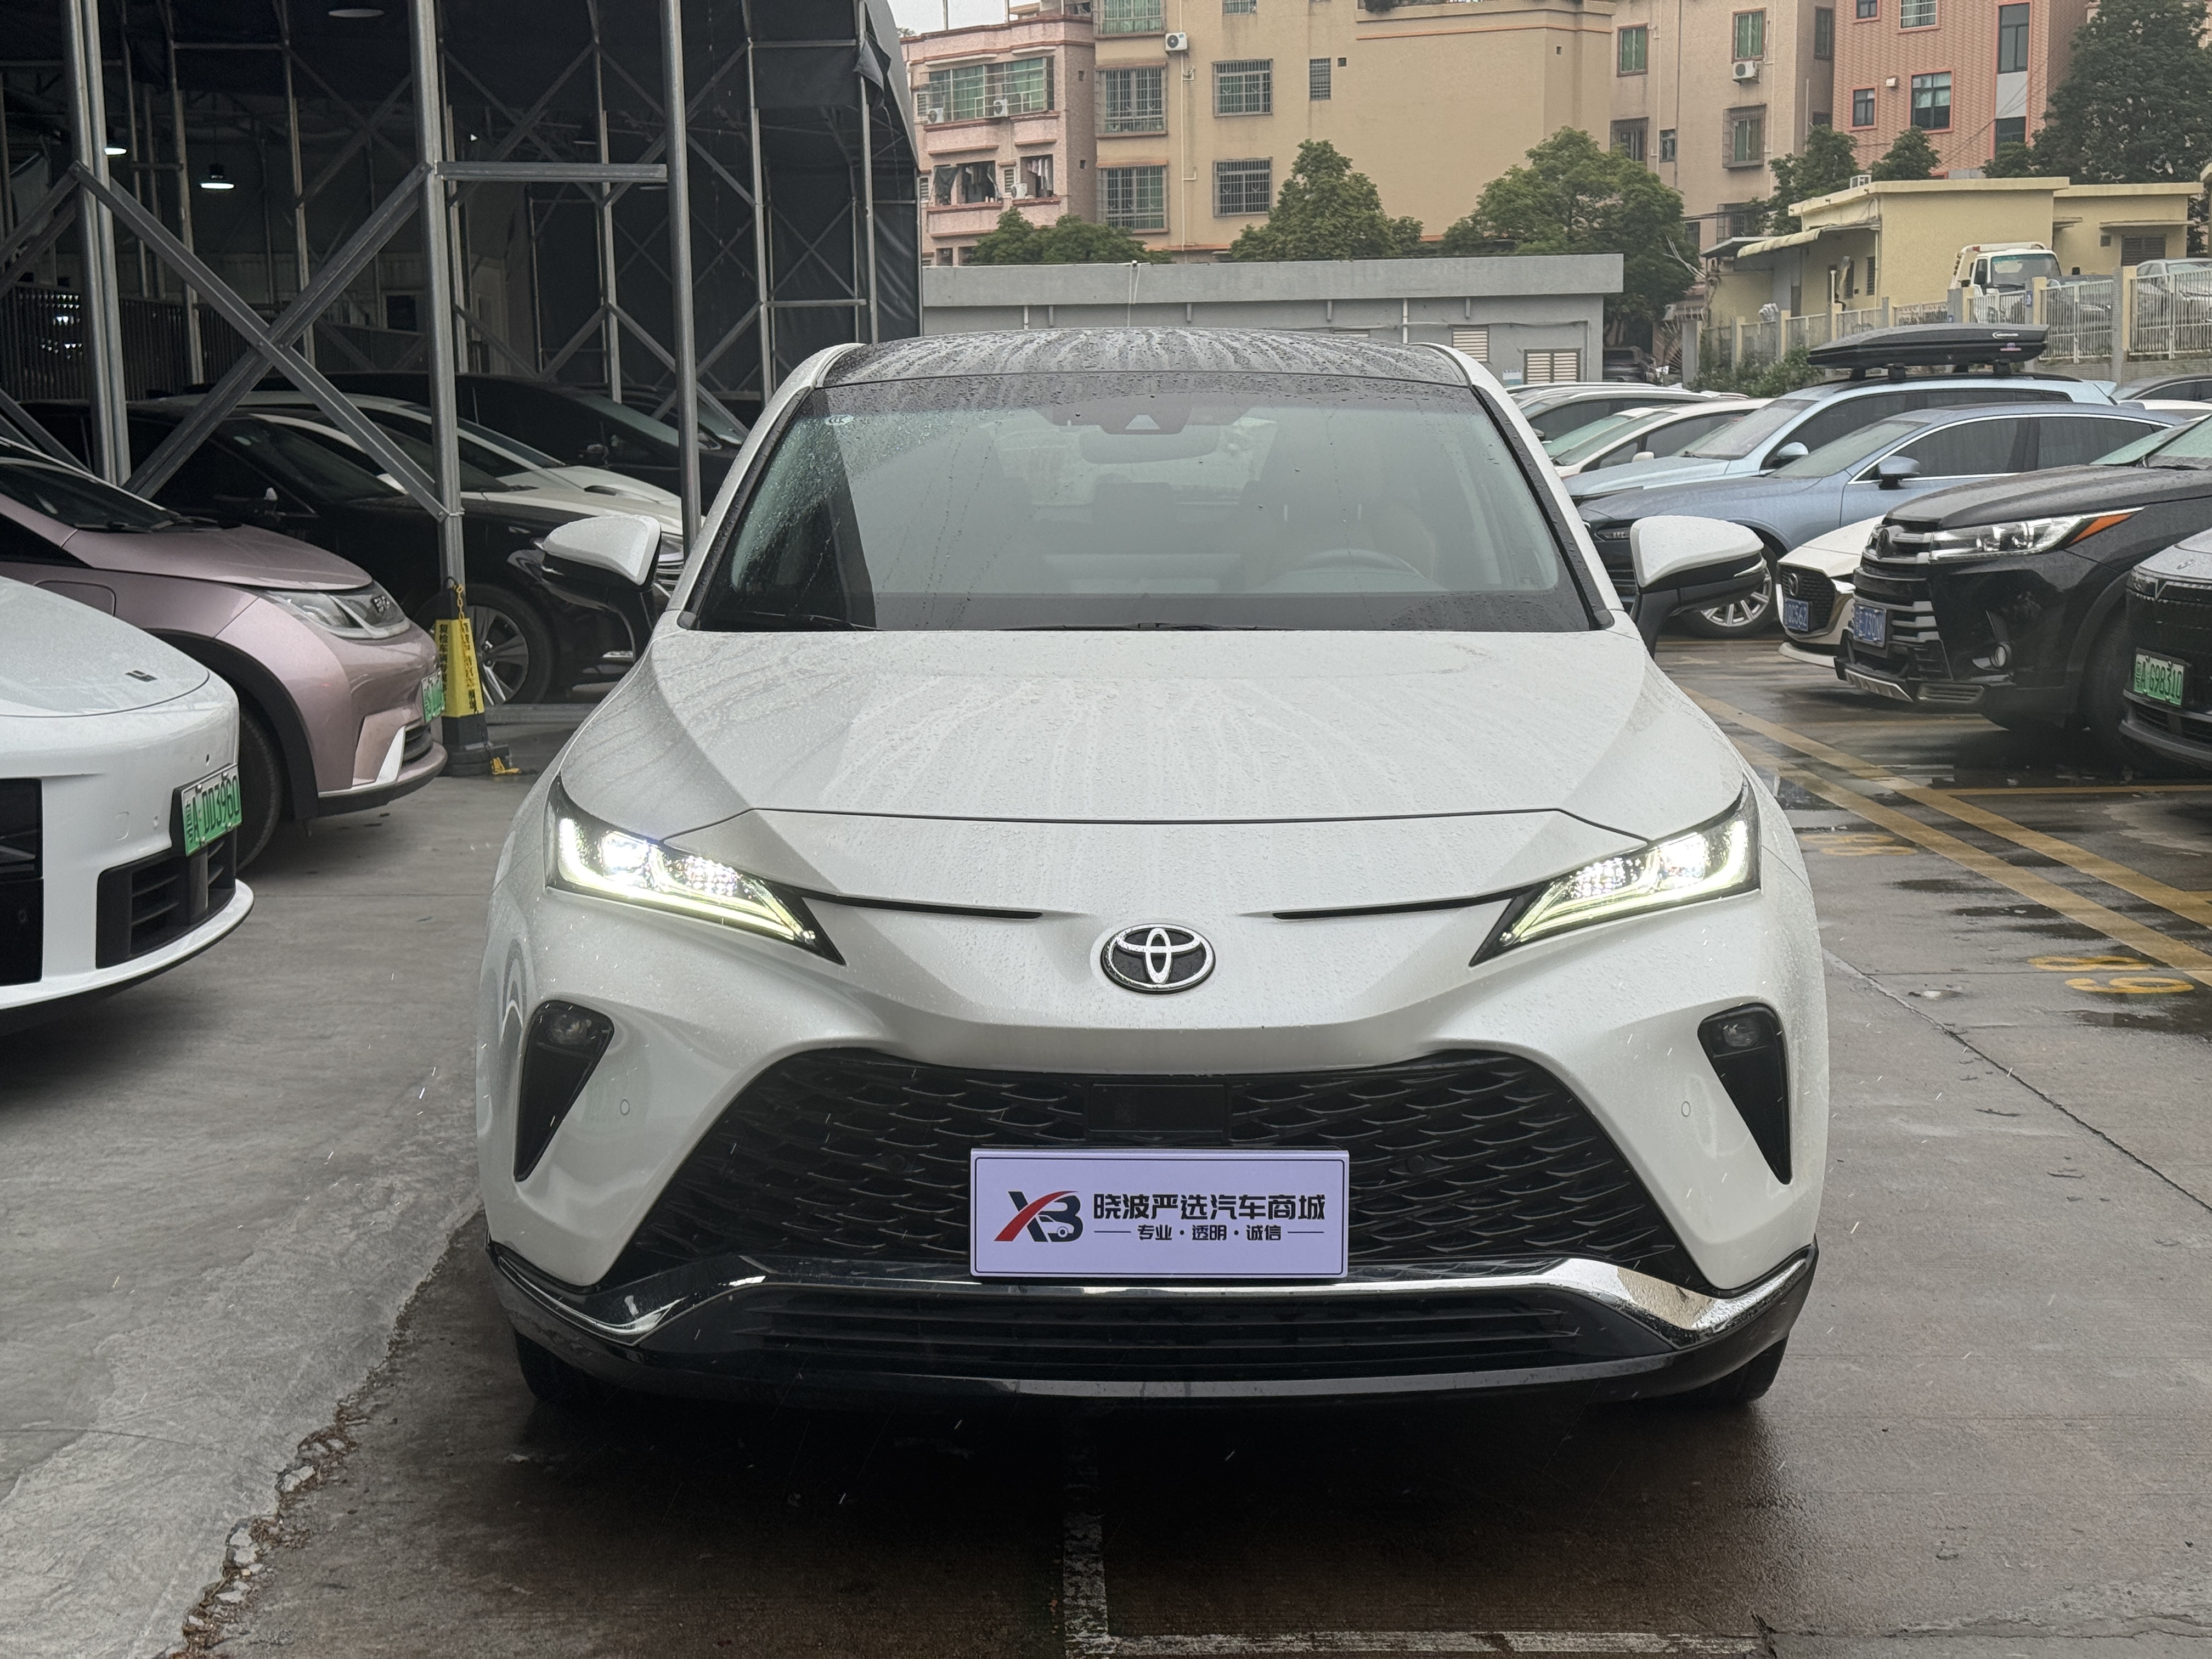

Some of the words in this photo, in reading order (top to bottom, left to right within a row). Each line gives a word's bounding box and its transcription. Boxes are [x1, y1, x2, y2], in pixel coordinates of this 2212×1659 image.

[1093, 1193, 1326, 1221] 晓波严选汽车商城
